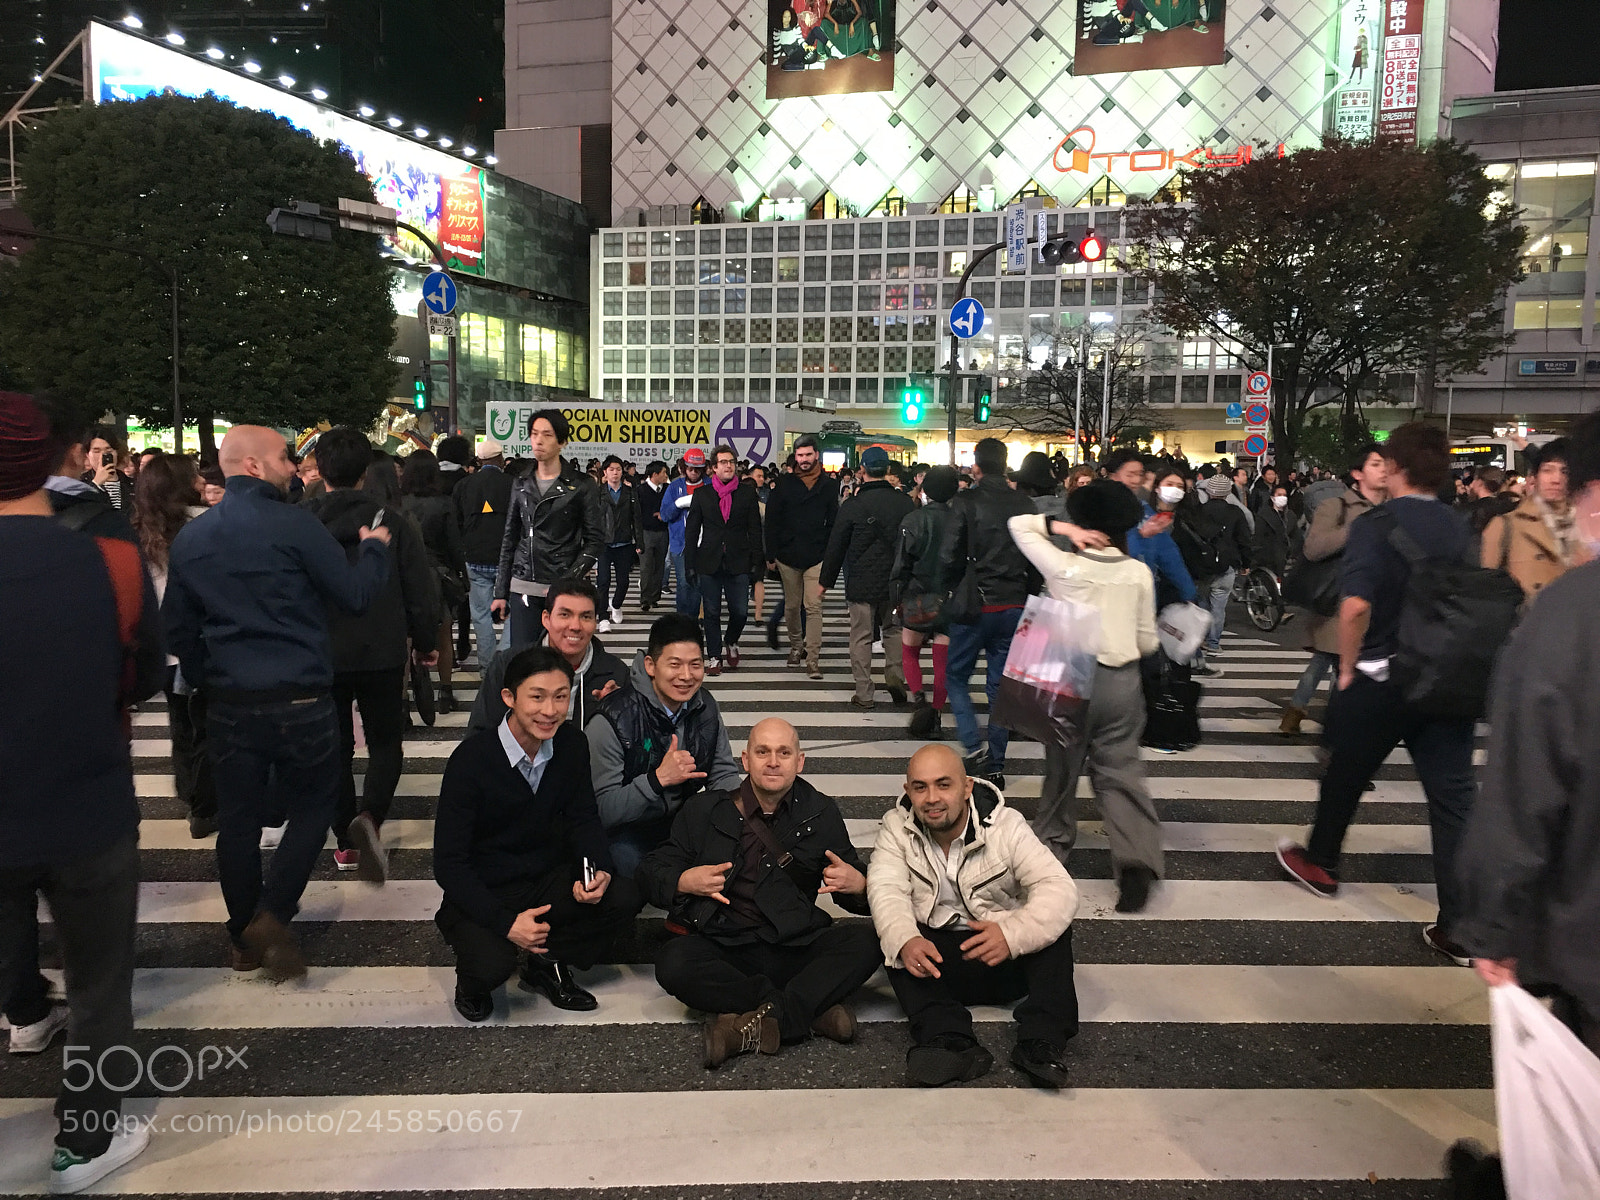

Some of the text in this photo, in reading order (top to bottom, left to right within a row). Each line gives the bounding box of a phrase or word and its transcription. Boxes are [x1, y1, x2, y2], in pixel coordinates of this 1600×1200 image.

[1354, 0, 1368, 26] ュウ
[1390, 0, 1407, 33] 設中
[1391, 39, 1415, 49] 全国
[1396, 61, 1406, 106] 配送ギフト
[1406, 60, 1417, 106] 全国無料
[1015, 208, 1025, 266] 渋谷駅前
[561, 408, 711, 423] OCIAL INNOVATION
[567, 424, 710, 444] ROM SHIBUYA
[629, 448, 658, 457] DDSS
